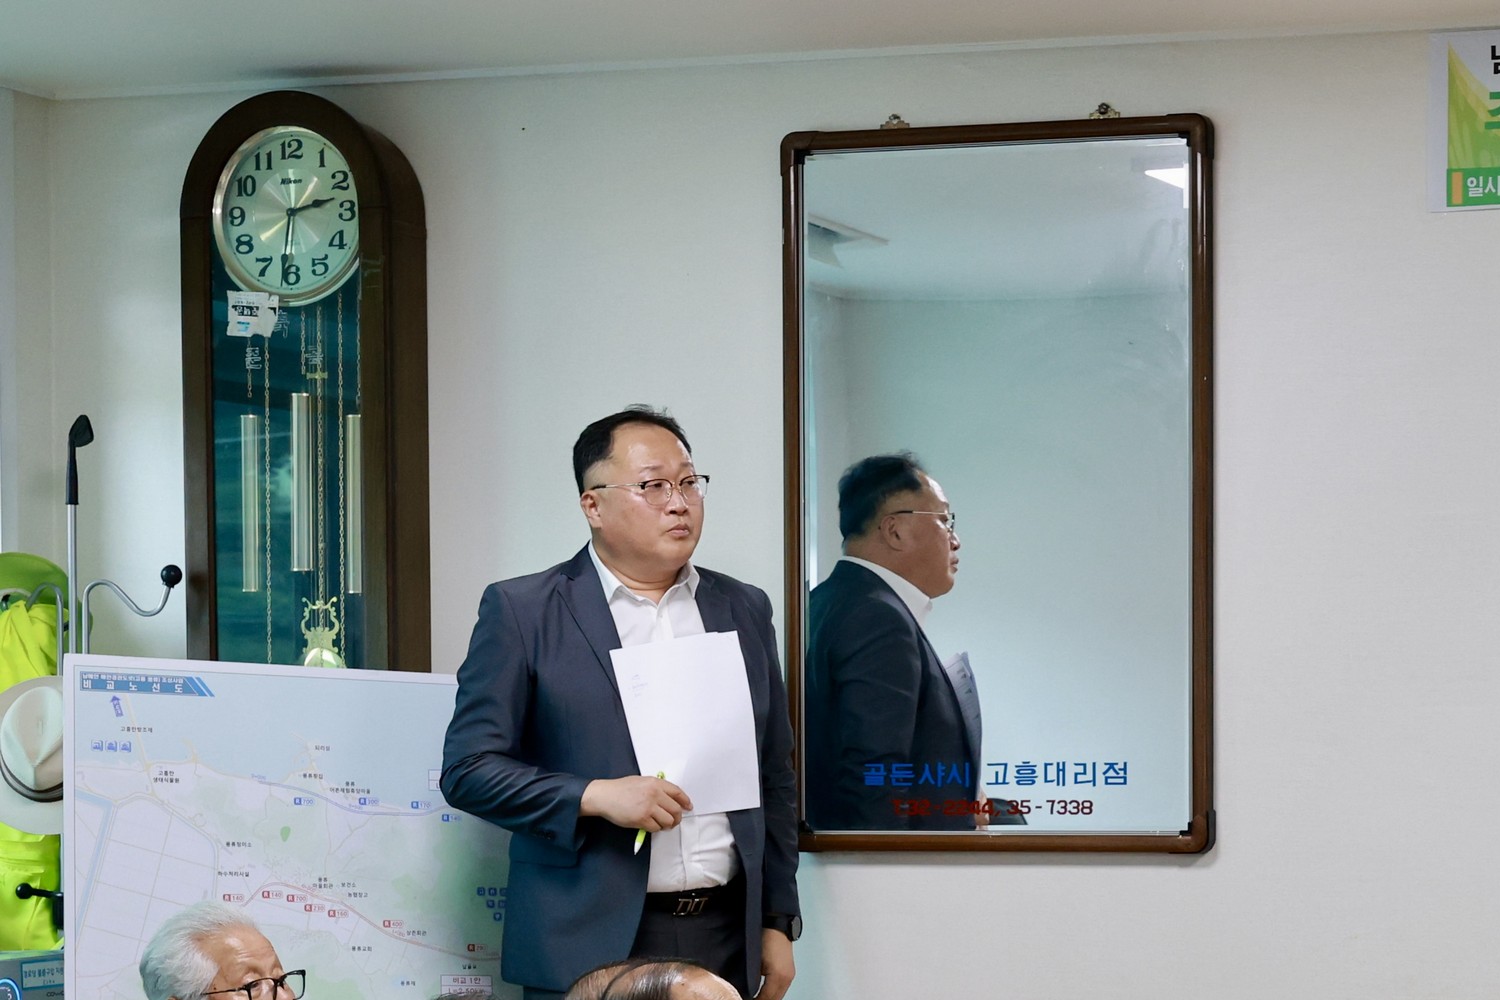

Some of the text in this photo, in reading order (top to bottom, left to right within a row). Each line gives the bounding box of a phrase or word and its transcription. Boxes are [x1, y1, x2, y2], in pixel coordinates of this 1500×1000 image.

[280, 138, 304, 160] 12
[318, 147, 326, 168] 1
[254, 150, 273, 171] 11
[235, 175, 257, 197] 10
[331, 170, 349, 190] 2
[229, 206, 246, 227] 9
[338, 200, 356, 221] 3
[235, 234, 254, 255] 8
[328, 230, 348, 250] 4
[255, 255, 273, 278] 7
[283, 264, 301, 286] 6
[311, 254, 329, 276] 5
[862, 760, 1129, 788] 골든샤시 고흥대리점
[1007, 799, 1094, 816] 35-7338
